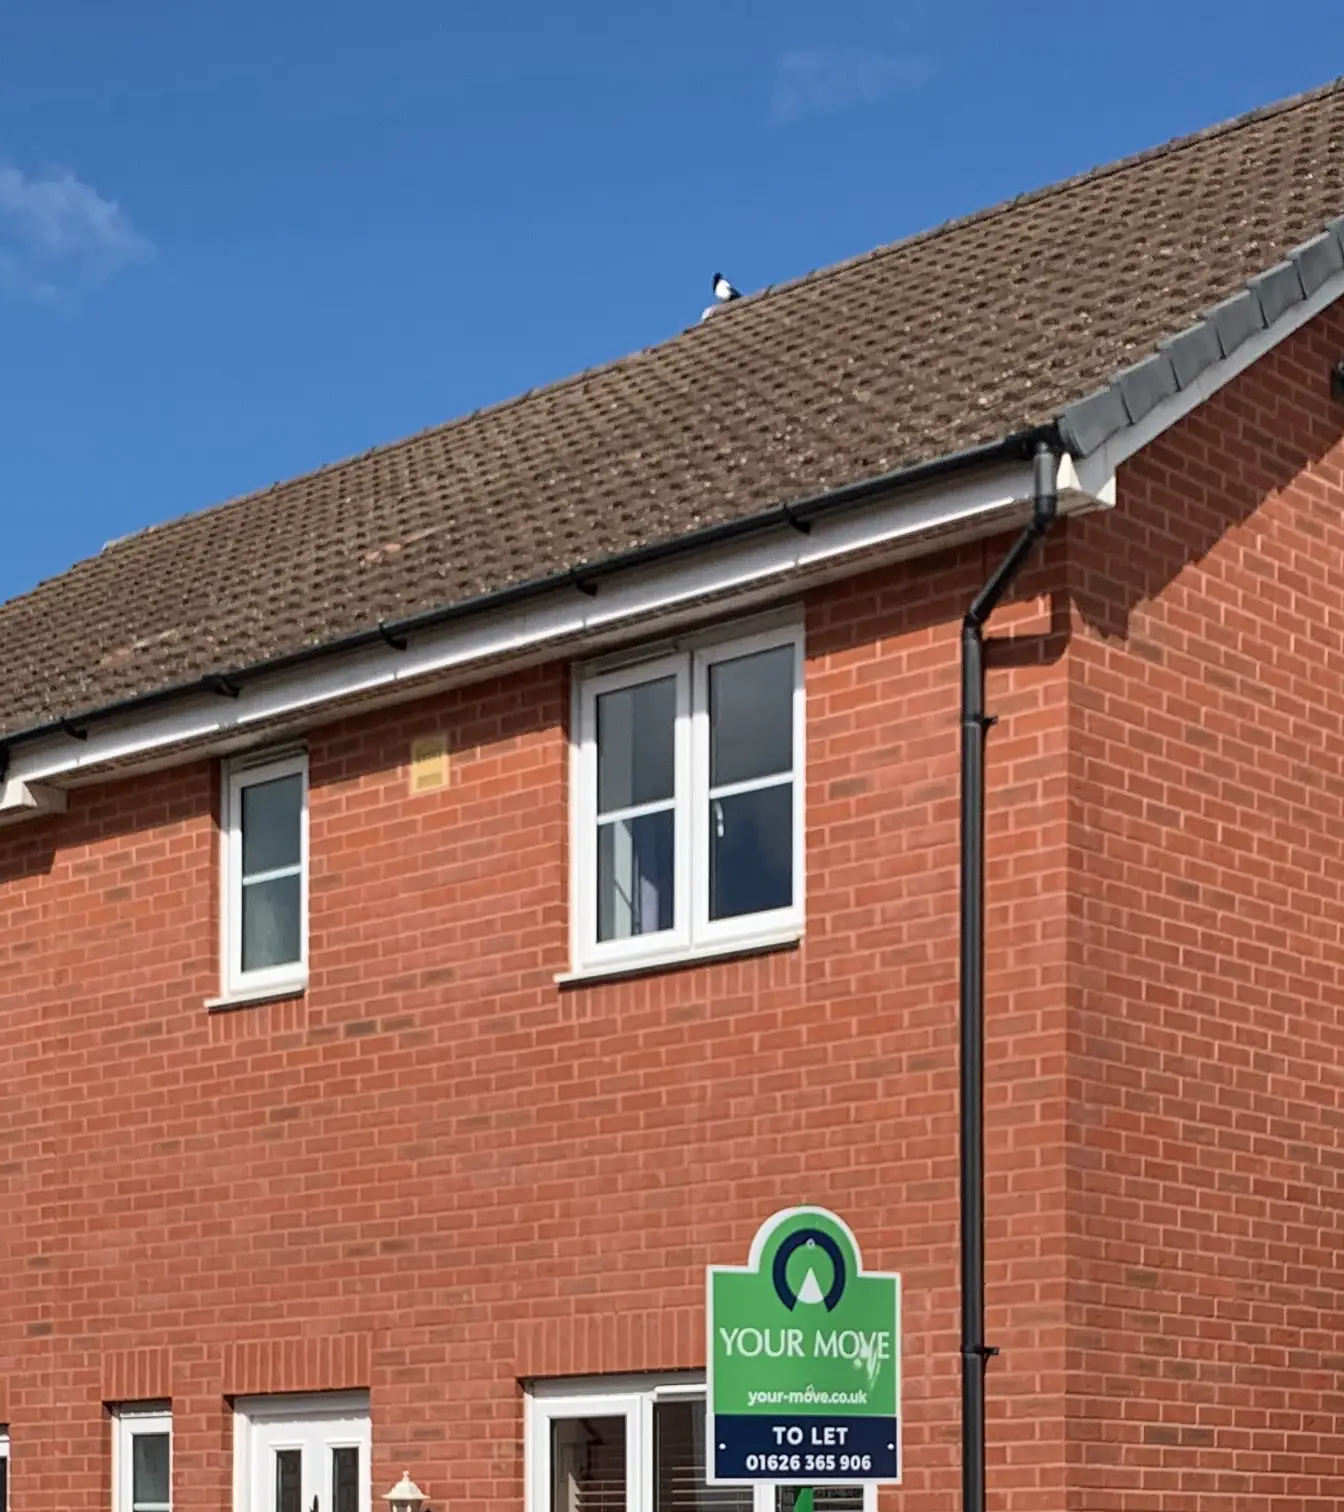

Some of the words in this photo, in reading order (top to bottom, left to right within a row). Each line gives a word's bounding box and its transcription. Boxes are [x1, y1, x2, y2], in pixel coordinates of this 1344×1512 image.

[719, 1328, 806, 1358] YOUR
[814, 1330, 890, 1360] MOVE
[747, 1388, 868, 1406] your-move.co.uk
[772, 1427, 804, 1446] TO
[811, 1427, 848, 1446] LET
[746, 1455, 801, 1472] 01626
[804, 1455, 836, 1472] 365
[840, 1455, 872, 1472] 906
